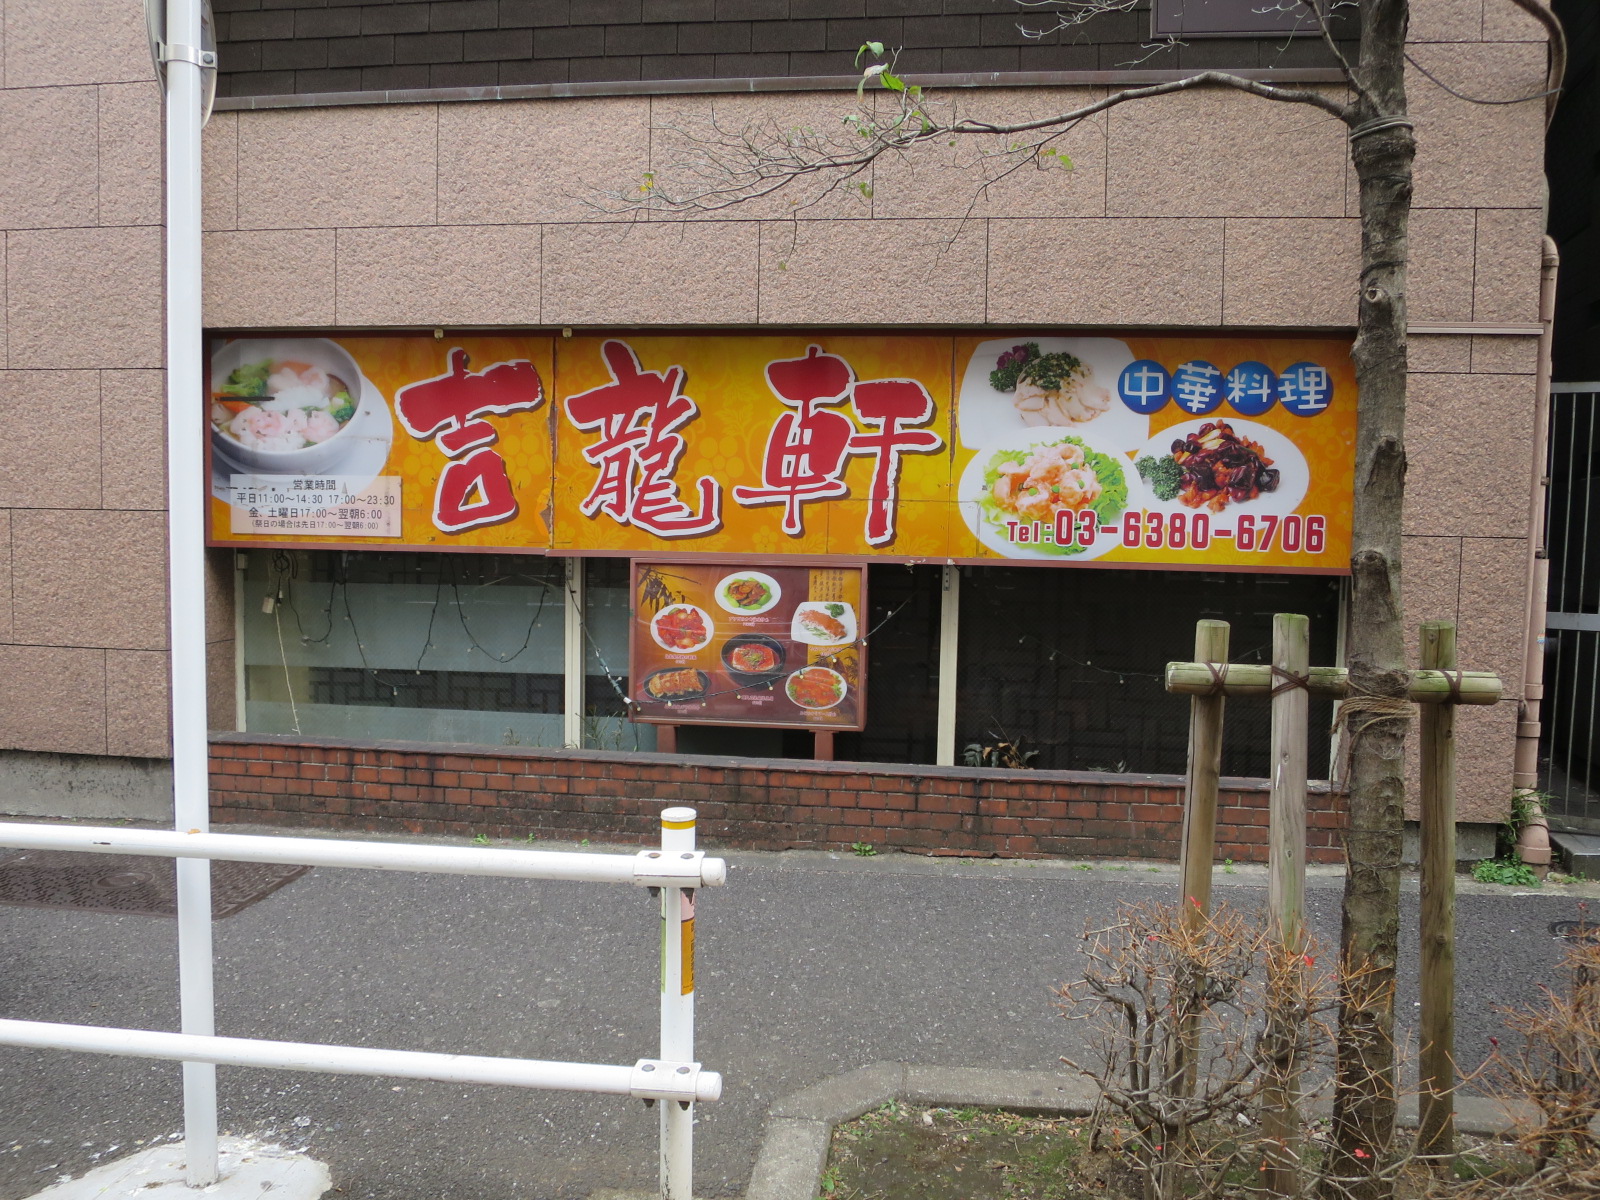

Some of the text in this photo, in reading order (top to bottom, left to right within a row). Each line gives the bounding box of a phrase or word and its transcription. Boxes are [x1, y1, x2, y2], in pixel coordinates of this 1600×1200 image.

[1122, 360, 1329, 412] 中華料理
[292, 479, 337, 491] 営業時間
